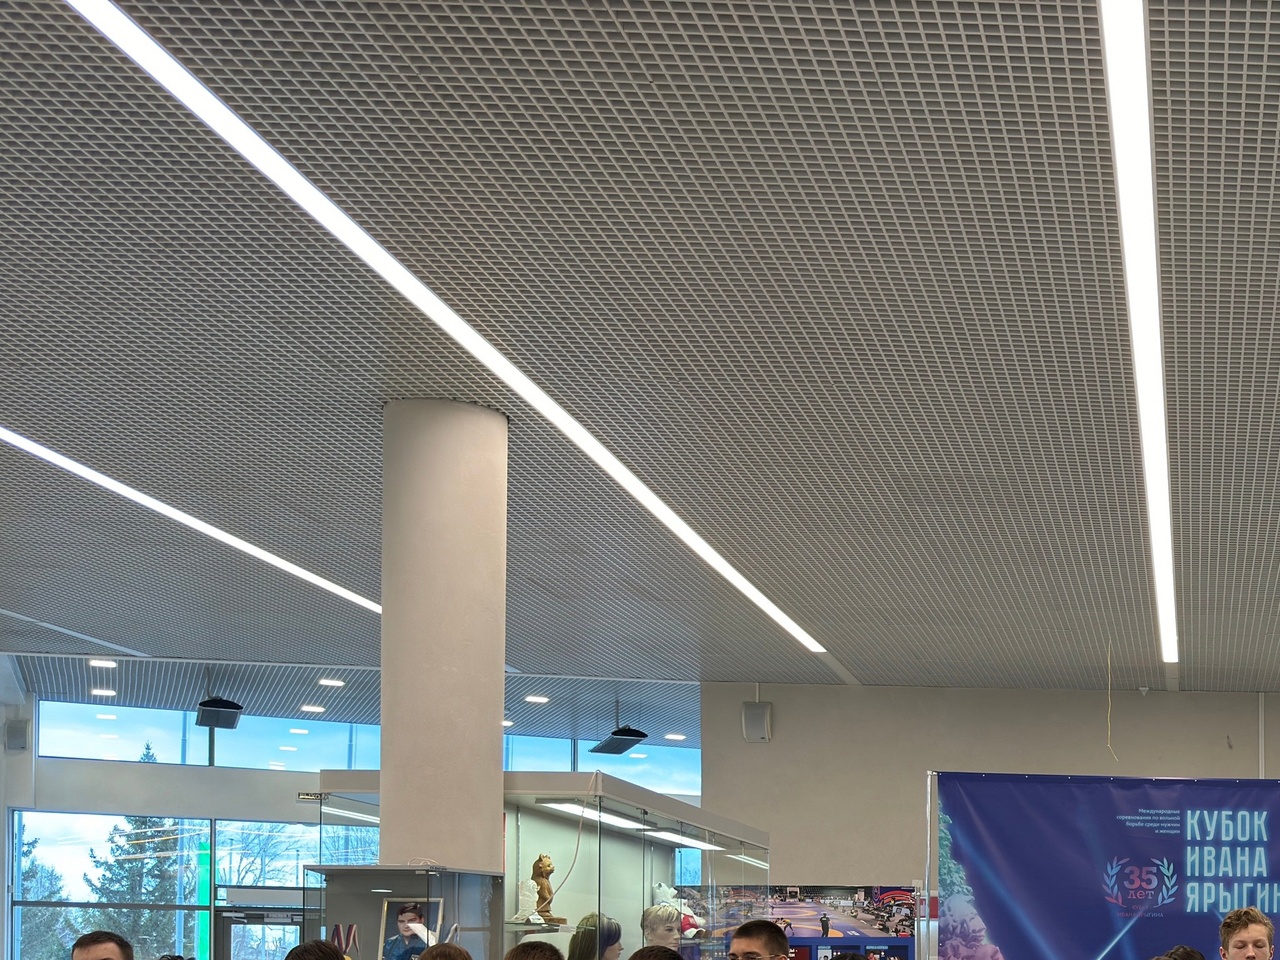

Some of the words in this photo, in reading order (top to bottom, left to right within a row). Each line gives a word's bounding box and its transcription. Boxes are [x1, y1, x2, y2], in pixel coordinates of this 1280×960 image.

[1186, 810, 1268, 841] КУБОК
[1186, 846, 1268, 877] ИВАНА
[1123, 866, 1158, 890] 35
[1127, 890, 1154, 899] лет
